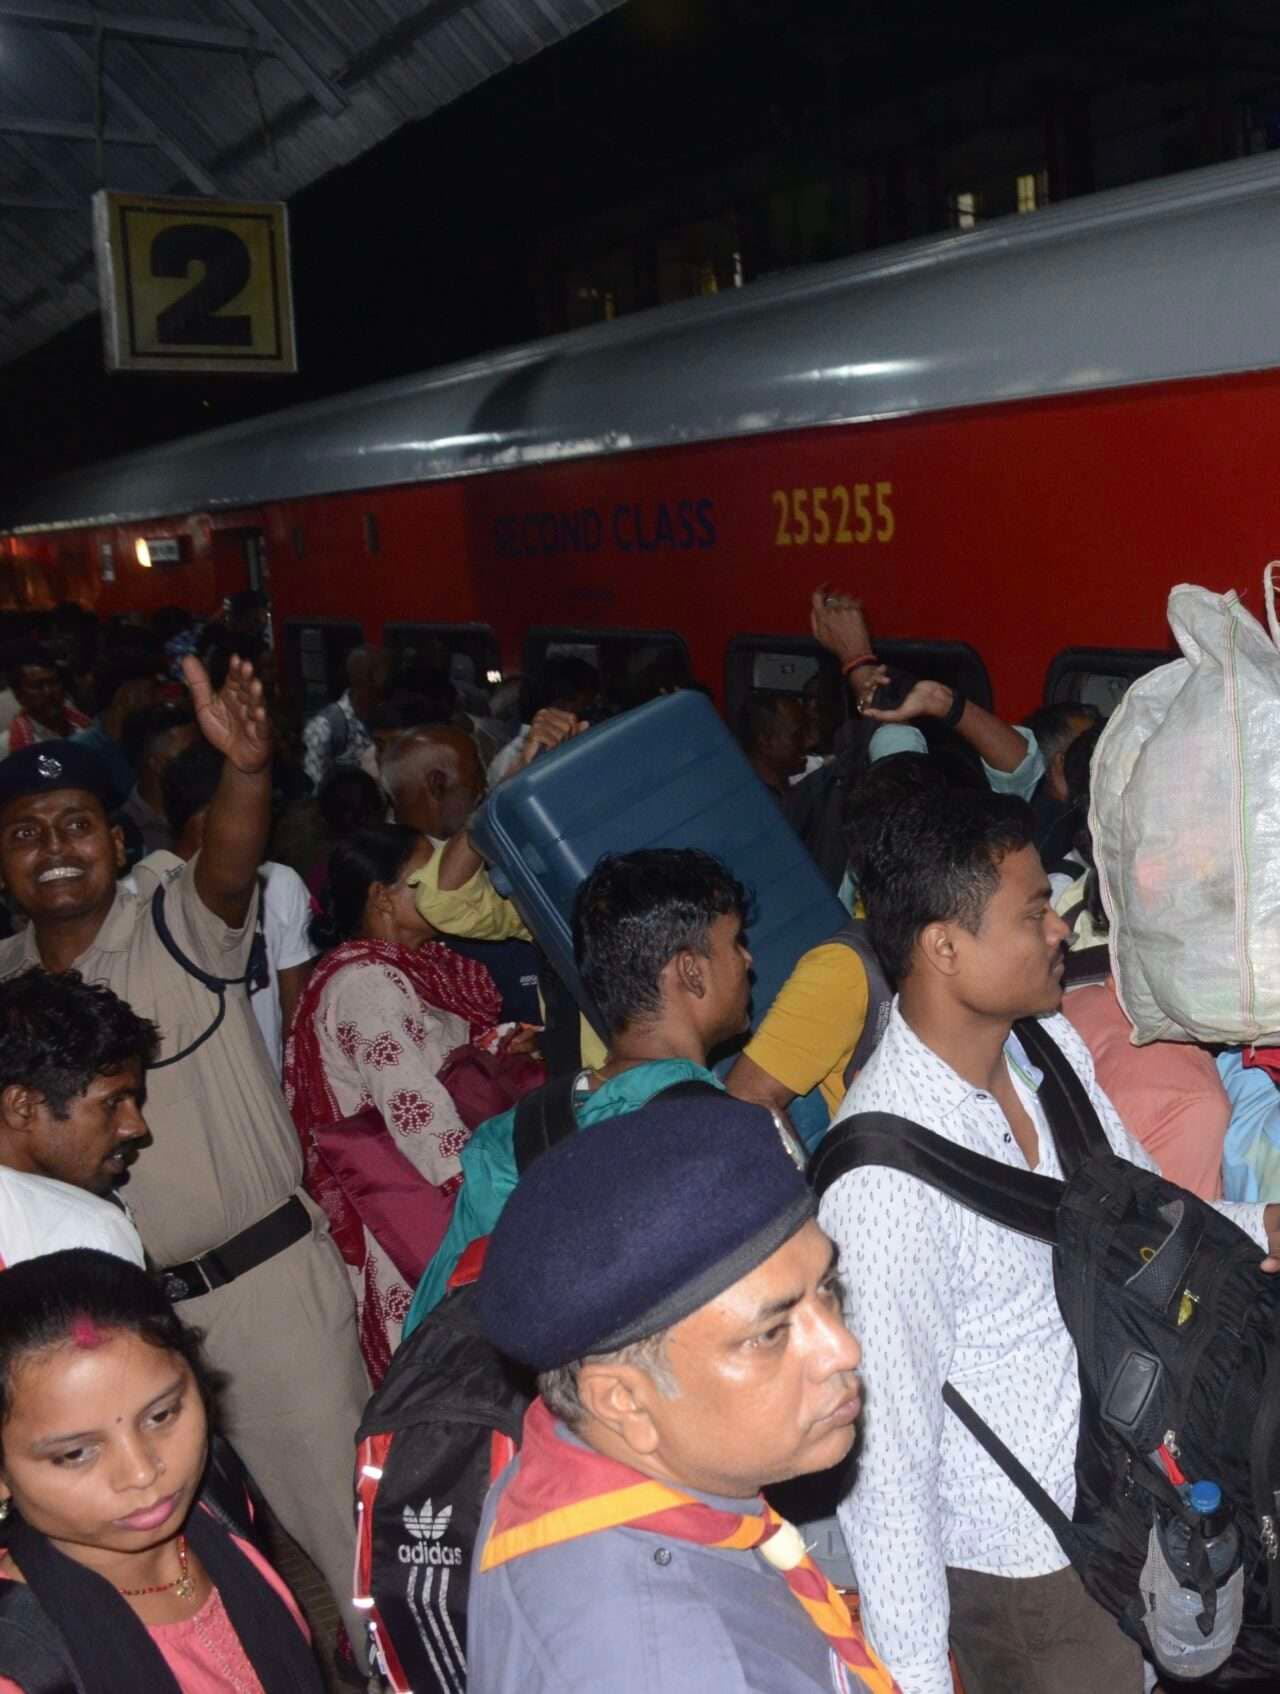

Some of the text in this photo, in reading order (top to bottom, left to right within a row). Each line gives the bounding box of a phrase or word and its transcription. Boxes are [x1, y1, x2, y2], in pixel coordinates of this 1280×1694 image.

[151, 223, 253, 346] 2
[612, 498, 718, 553] CLASS
[772, 481, 895, 545] 255255
[398, 1540, 462, 1566] adidas
